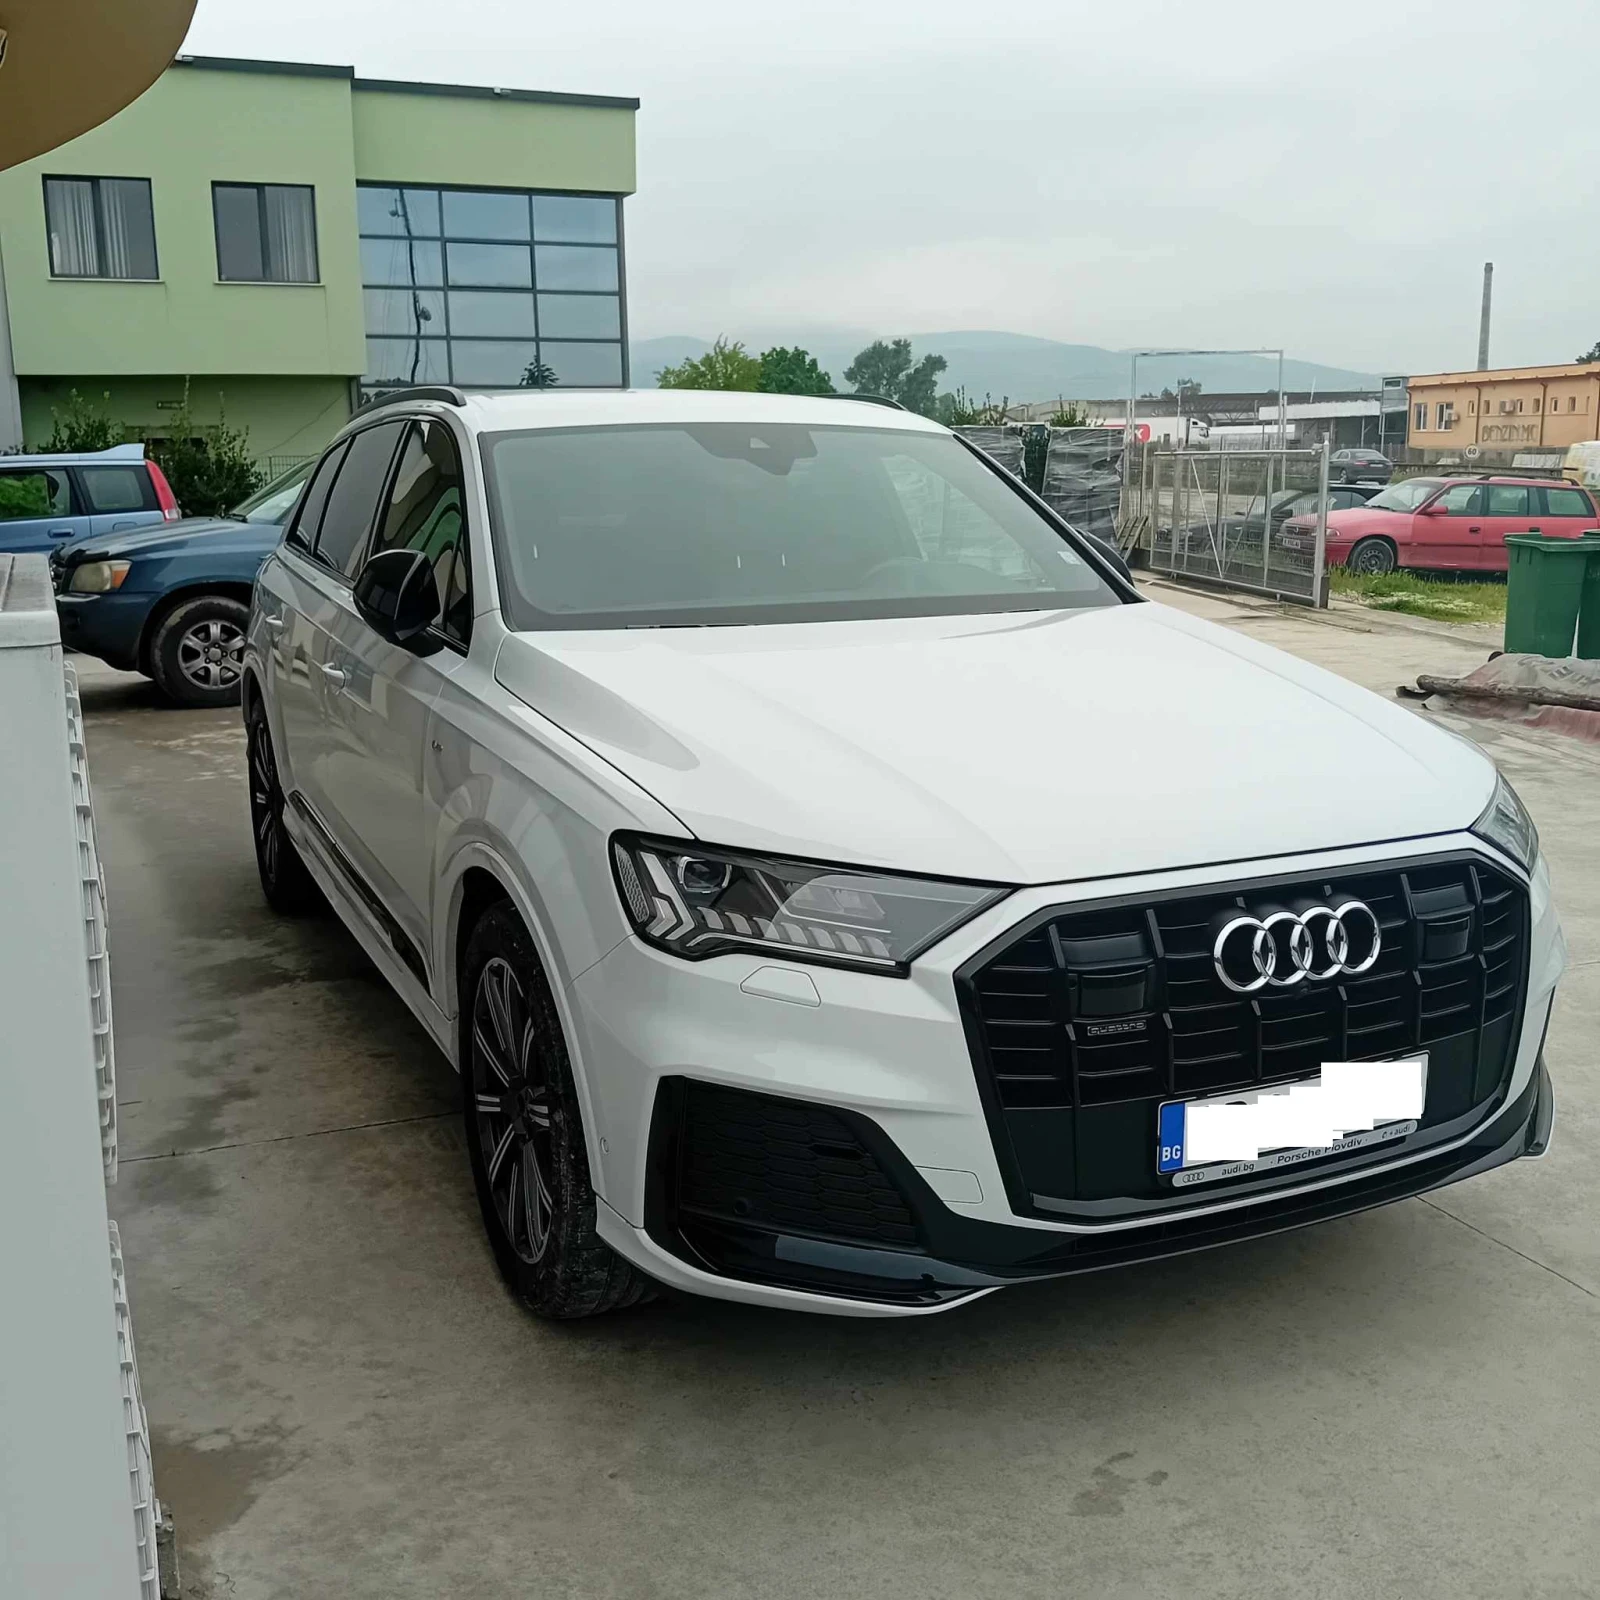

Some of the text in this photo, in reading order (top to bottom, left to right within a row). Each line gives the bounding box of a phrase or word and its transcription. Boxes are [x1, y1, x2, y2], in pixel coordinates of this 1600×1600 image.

[1467, 448, 1477, 456] 60
[1162, 1145, 1181, 1161] BG
[1221, 1162, 1255, 1176] audi.bg
[1277, 1147, 1322, 1165] Porsche
